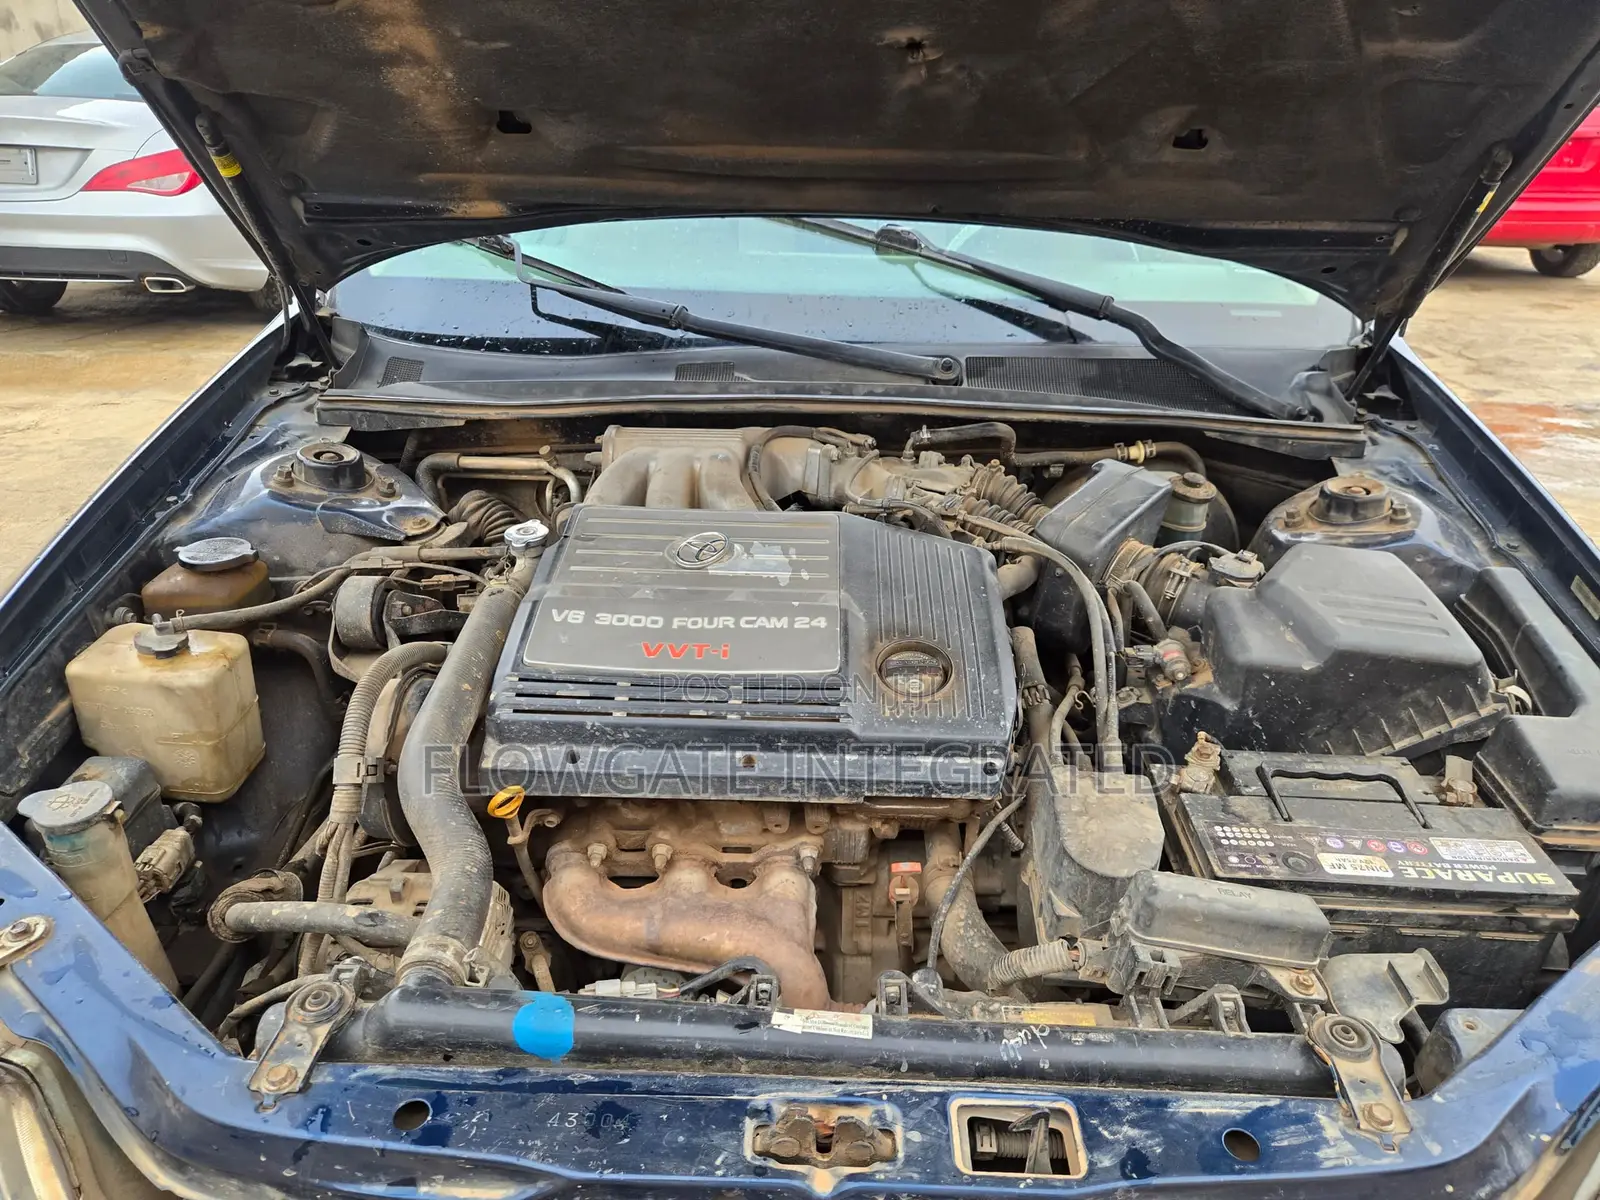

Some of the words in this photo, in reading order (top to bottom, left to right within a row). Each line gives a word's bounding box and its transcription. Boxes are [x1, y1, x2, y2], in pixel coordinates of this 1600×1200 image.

[551, 609, 585, 624] V6
[594, 613, 664, 628] 3000
[672, 616, 735, 629] FOUR
[739, 616, 788, 629] CAM
[794, 616, 827, 629] 24
[641, 641, 730, 659] VVT-i
[1396, 859, 1450, 870] BATTERY
[1450, 862, 1497, 871] POWER
[1397, 866, 1556, 886] SUPARACE
[1217, 887, 1251, 899] RELAY
